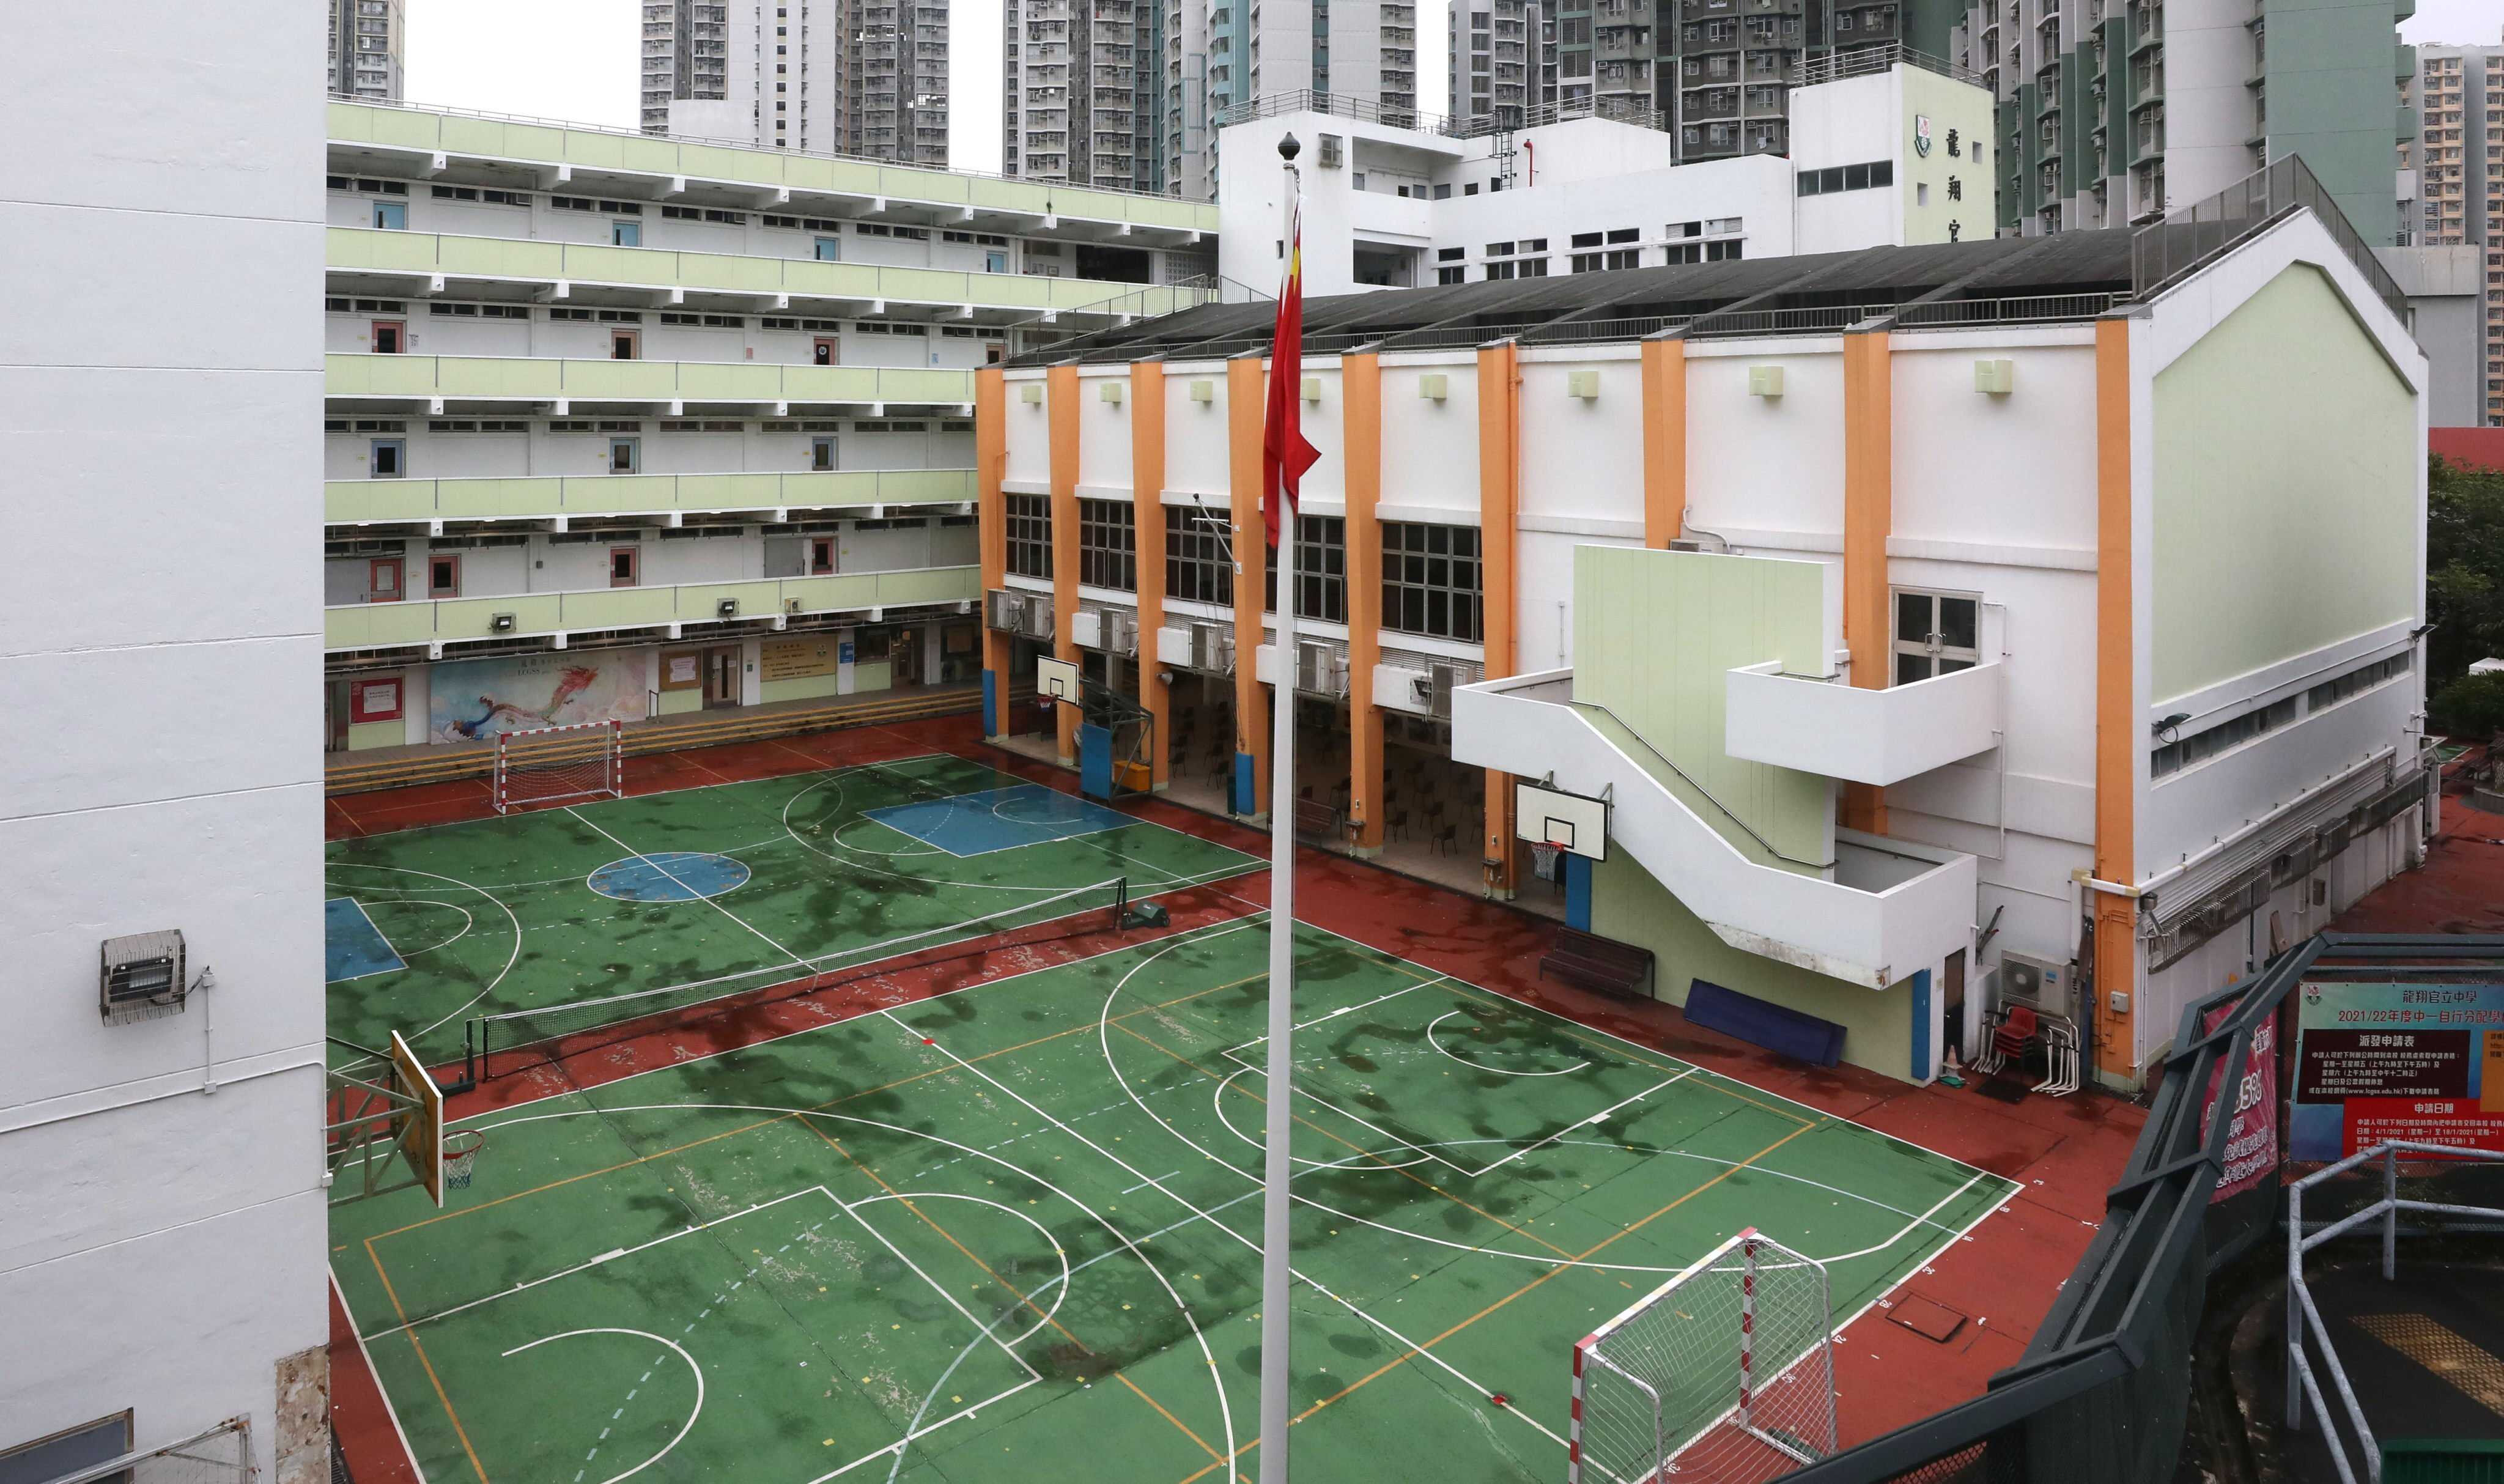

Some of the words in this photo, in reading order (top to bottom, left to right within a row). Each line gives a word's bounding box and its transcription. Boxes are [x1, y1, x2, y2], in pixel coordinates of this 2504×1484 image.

[2402, 990, 2477, 1003] 龍翔官立中學
[2359, 1035, 2415, 1047] 派發申請表
[2415, 1102, 2454, 1113] 申請日期
[1922, 1266, 1935, 1275] 2C
[1878, 1299, 1893, 1309] 2B
[1832, 1334, 1847, 1344] 2A
